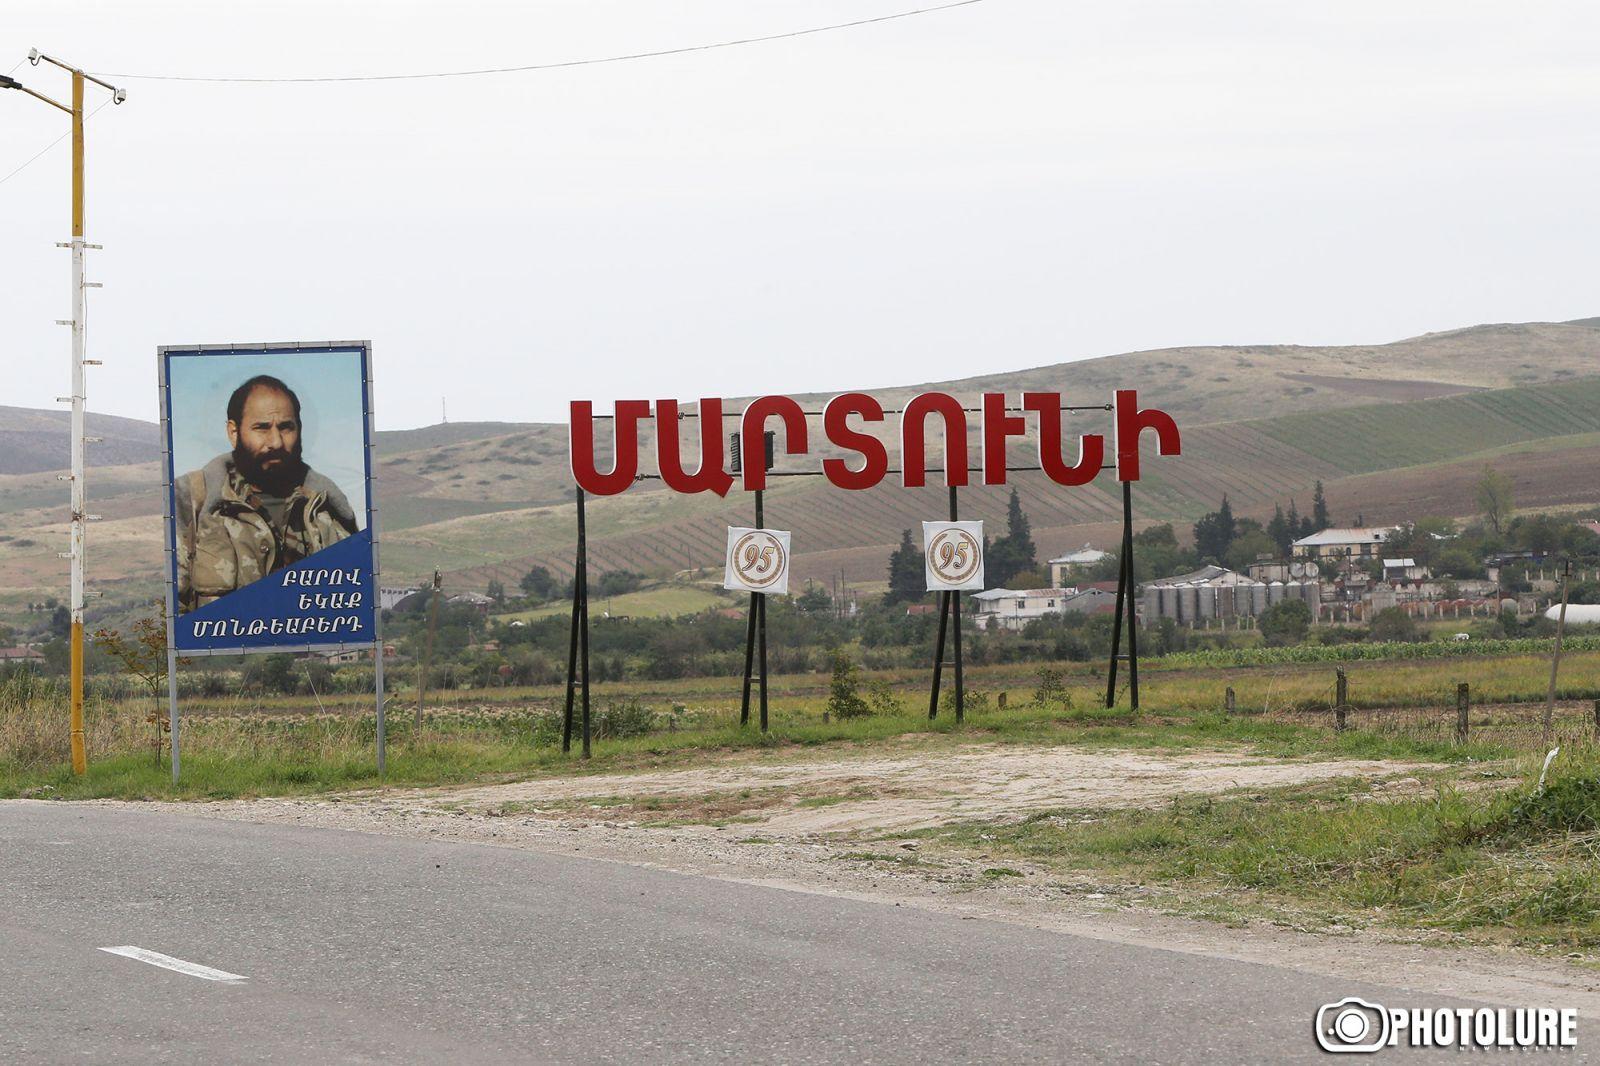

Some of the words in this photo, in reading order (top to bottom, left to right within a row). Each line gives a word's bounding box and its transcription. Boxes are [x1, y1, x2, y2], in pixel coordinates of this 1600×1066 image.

[569, 390, 1181, 498] ՄԱՐՏՈՒՆԻ
[742, 544, 775, 573] 95
[939, 542, 968, 569] 95
[281, 568, 362, 587] ԲԱՐՈՎ
[298, 592, 362, 610] ԵԿԱՔ
[192, 616, 363, 637] ՄՈՆԹԵԱԲԵՐԴ
